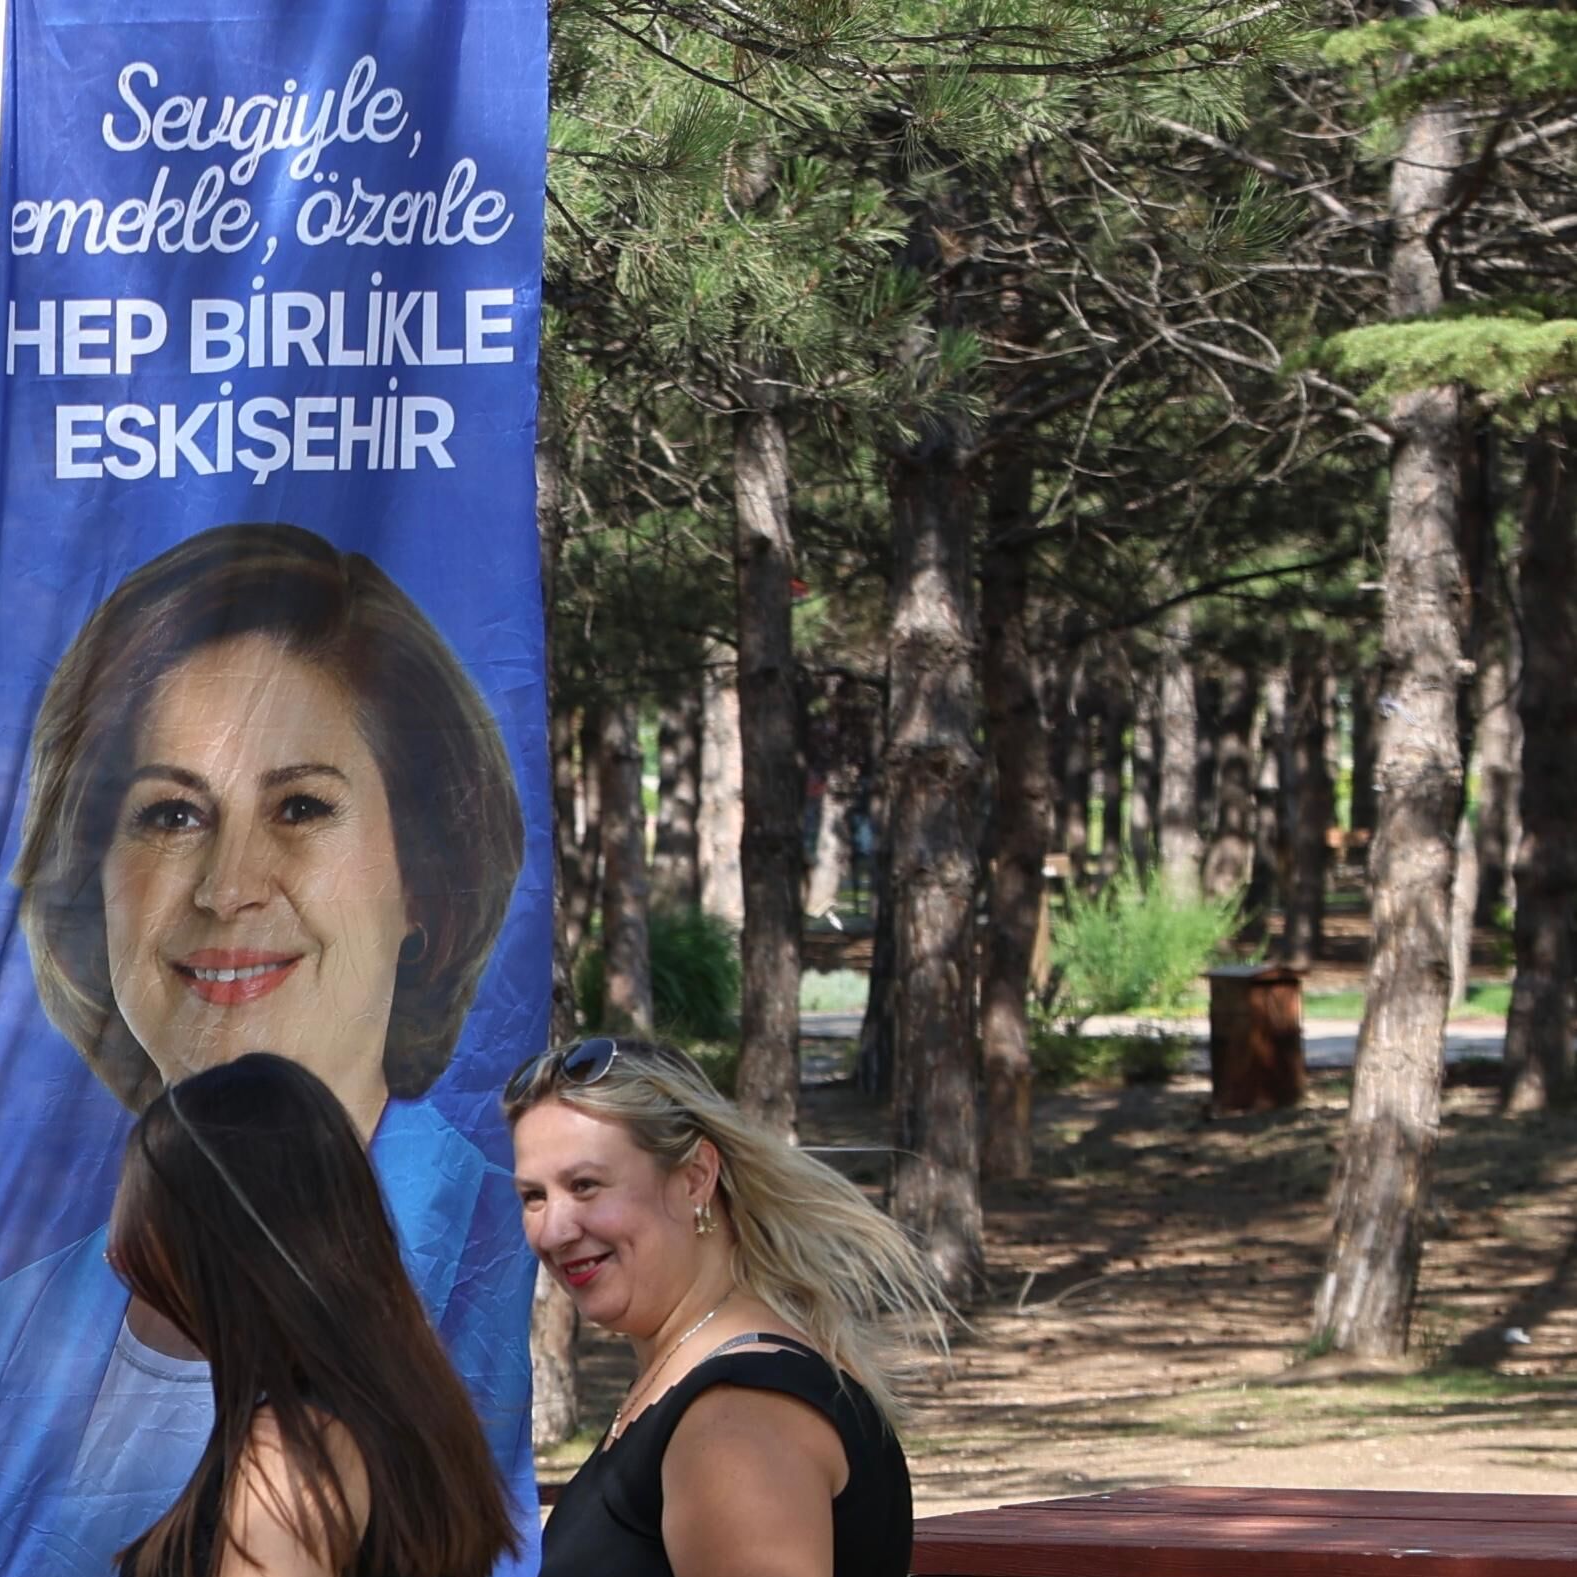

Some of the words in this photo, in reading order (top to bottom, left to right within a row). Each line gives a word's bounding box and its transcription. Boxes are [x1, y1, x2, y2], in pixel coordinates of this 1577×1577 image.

[102, 55, 423, 185] Sevgiyle,
[296, 157, 515, 247] özenle
[6, 299, 168, 376] HEP
[189, 272, 515, 375] BİRLİKLE
[55, 377, 456, 486] ESKİŞEHİR
